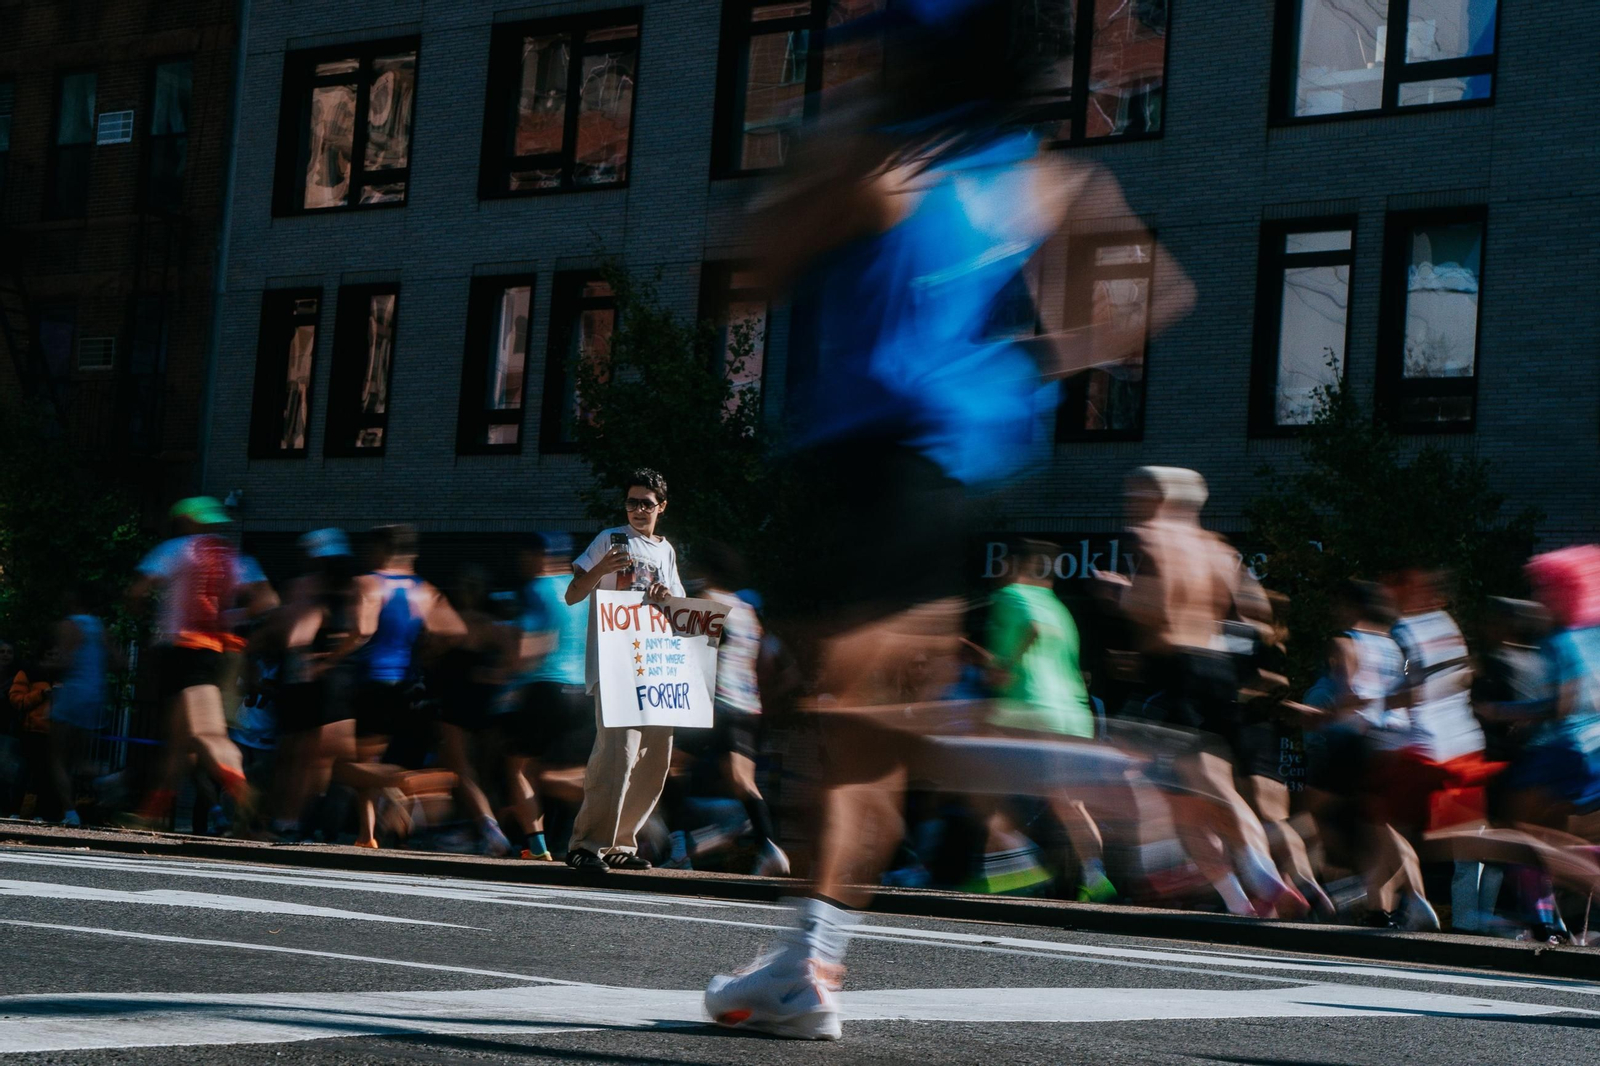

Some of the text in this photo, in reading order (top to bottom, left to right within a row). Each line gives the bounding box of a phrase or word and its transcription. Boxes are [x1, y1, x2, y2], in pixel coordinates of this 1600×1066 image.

[981, 538, 1146, 584] Brookly
[600, 602, 725, 638] NOT RACING
[646, 653, 685, 664] ANY WHERE
[648, 665, 678, 677] ANY DAY
[636, 682, 690, 711] FOREVER
